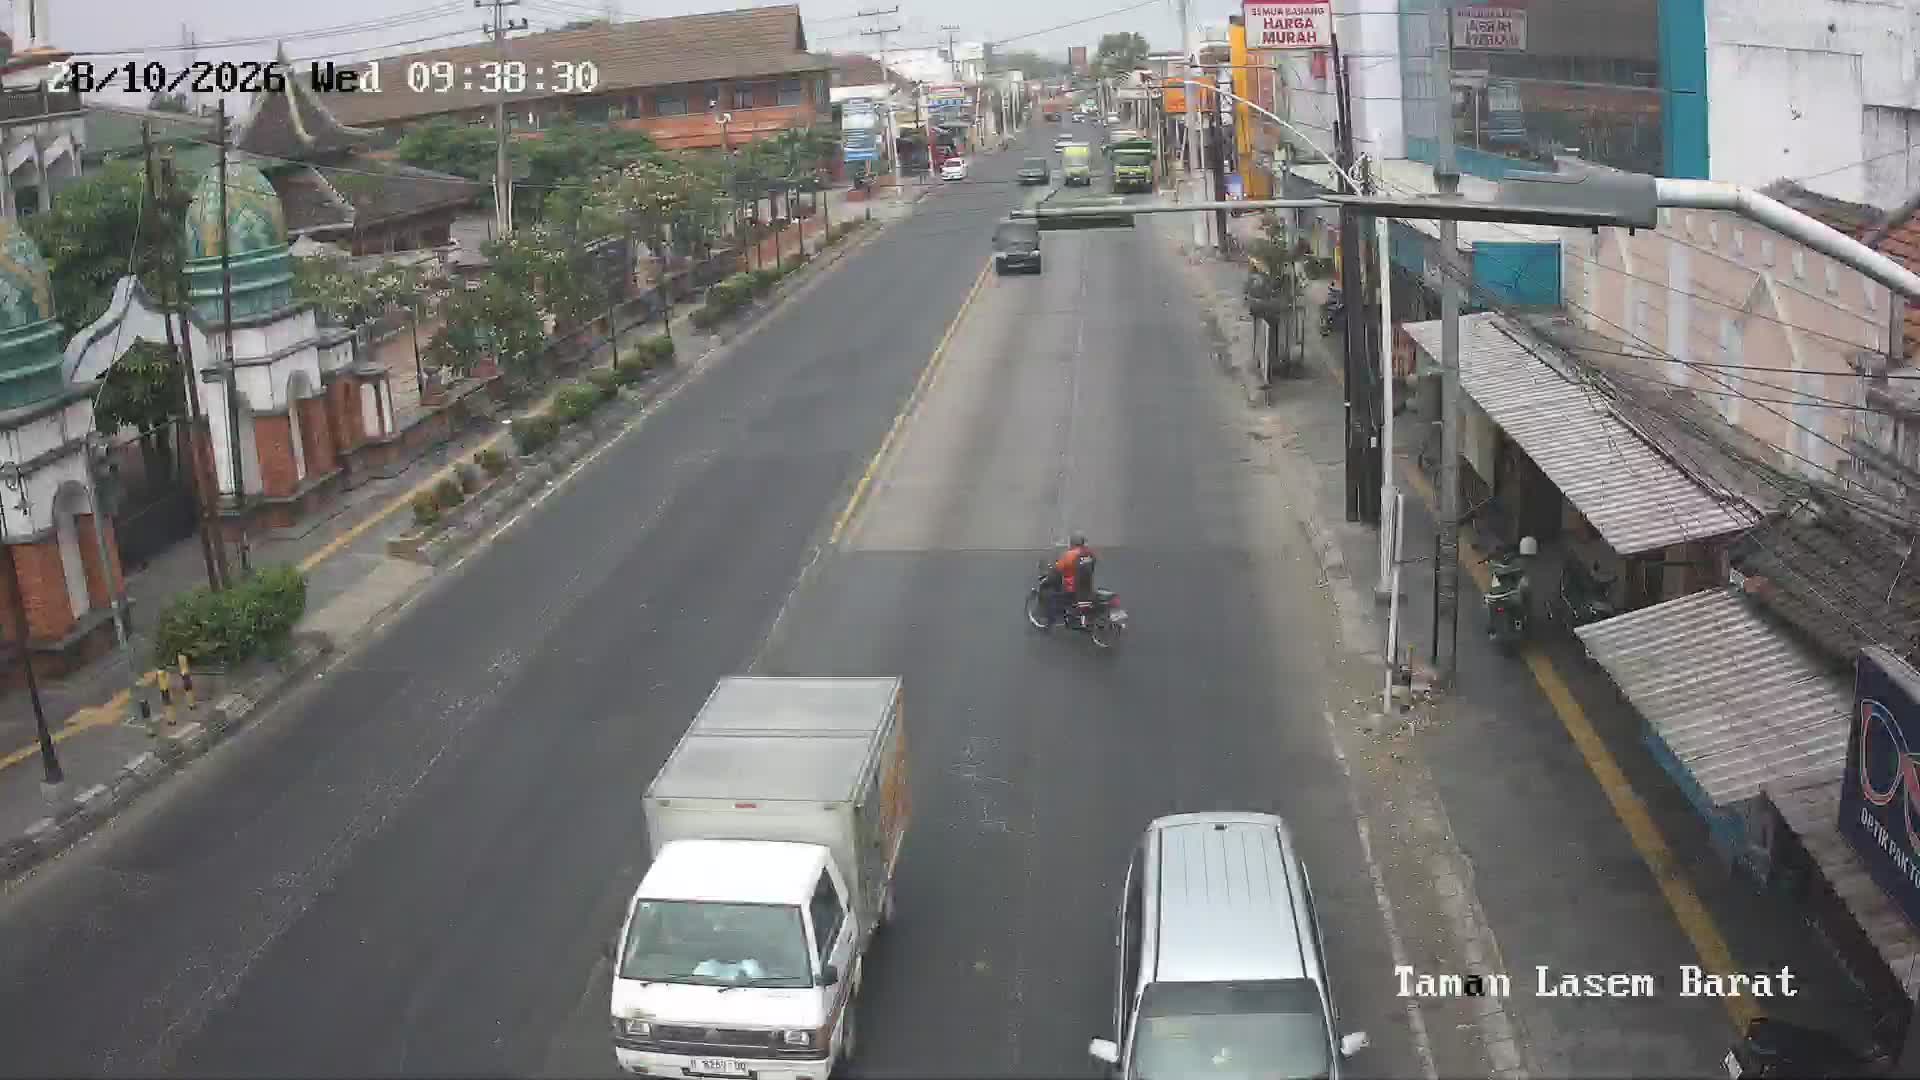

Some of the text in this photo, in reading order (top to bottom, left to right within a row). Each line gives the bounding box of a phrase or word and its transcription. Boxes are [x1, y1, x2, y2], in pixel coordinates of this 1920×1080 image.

[1263, 17, 1314, 30] HARGA
[1262, 31, 1317, 44] MURAH
[1860, 807, 1889, 850] OPTIK
[1889, 839, 1909, 873] PAK
